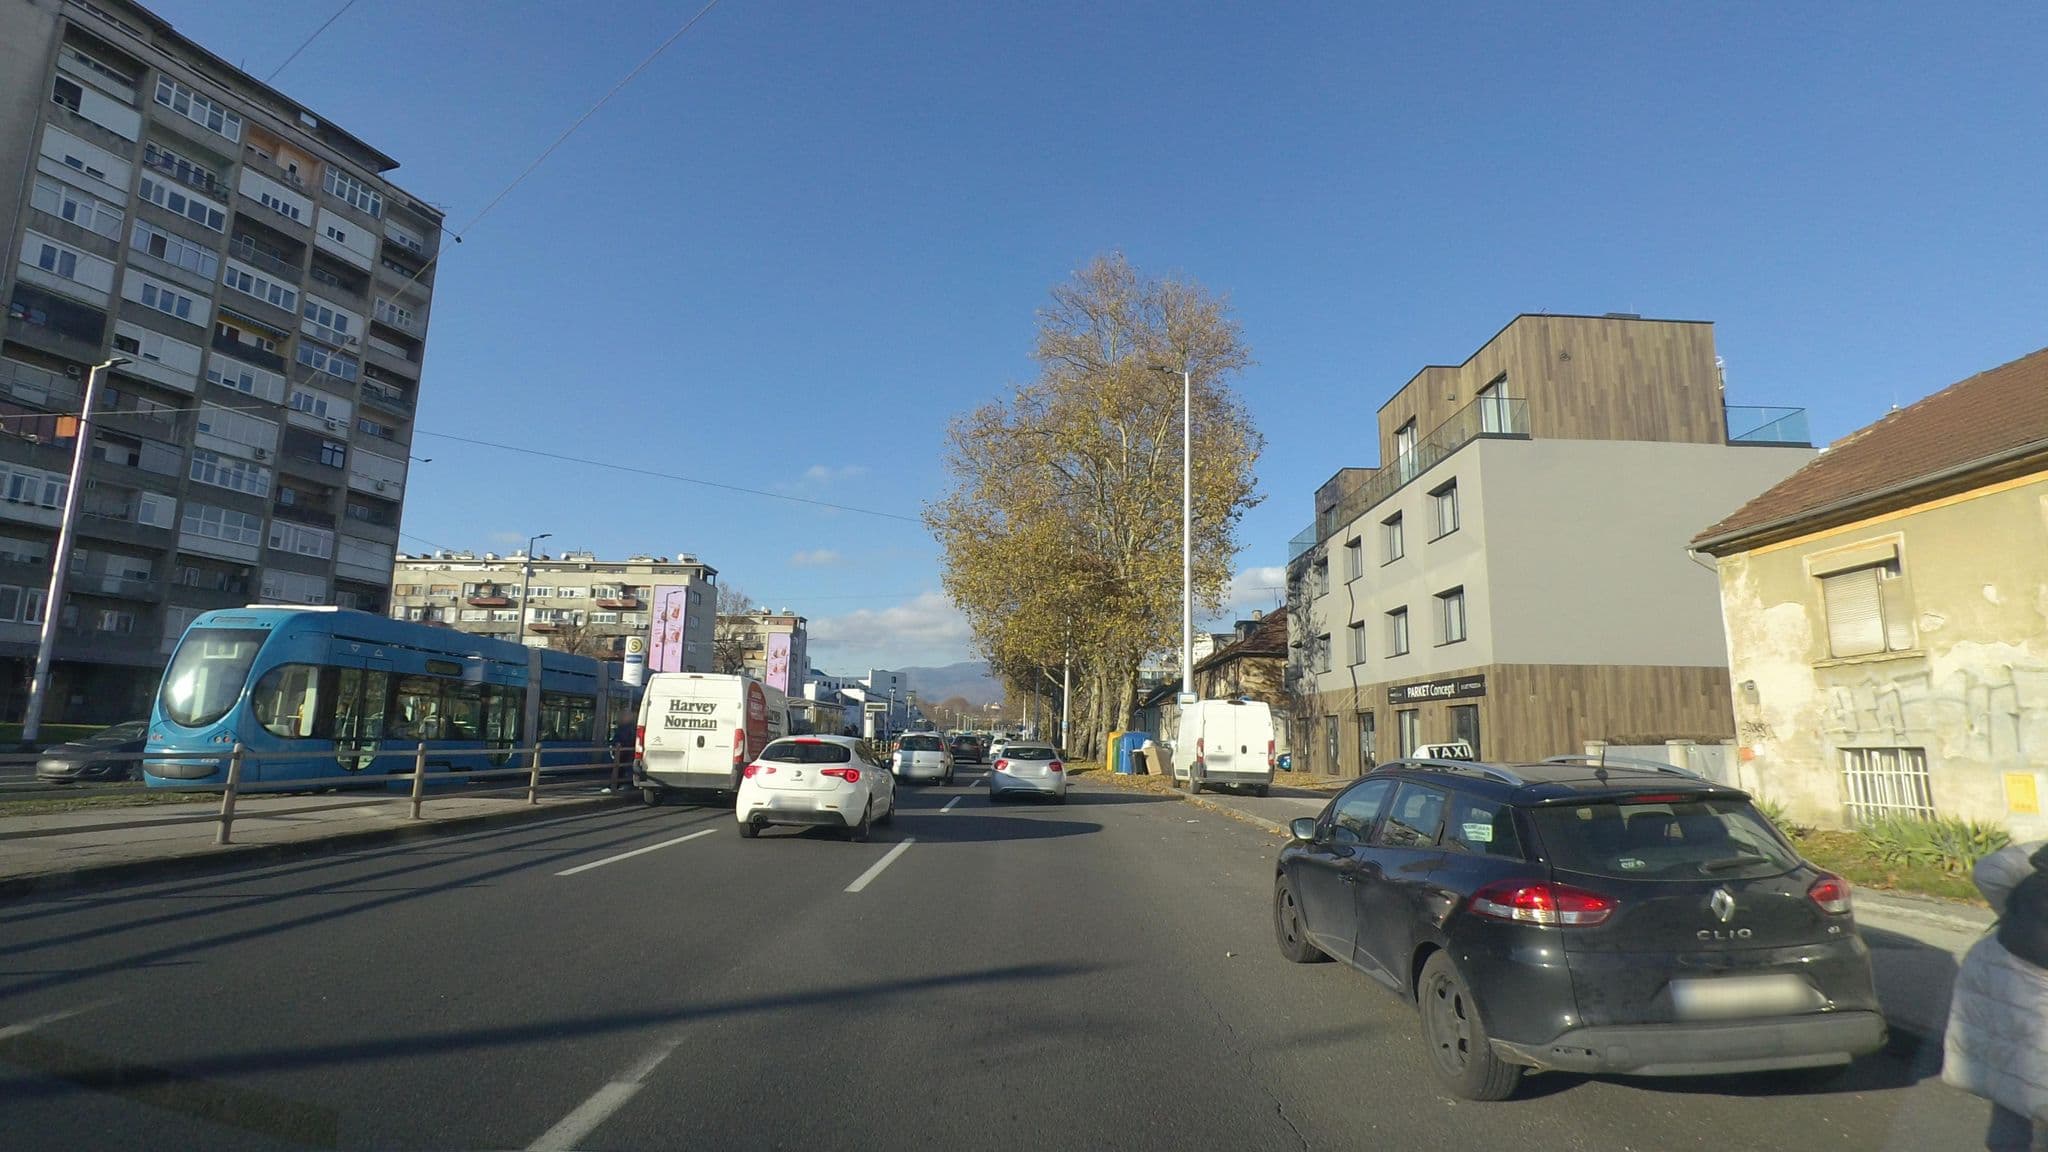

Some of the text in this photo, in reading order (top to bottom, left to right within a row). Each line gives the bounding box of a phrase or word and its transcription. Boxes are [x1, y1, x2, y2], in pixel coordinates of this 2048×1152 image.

[1407, 684, 1430, 698] PARKET
[1430, 683, 1456, 698] Concept
[669, 699, 717, 715] Harvey
[664, 715, 717, 729] Norman
[1430, 746, 1469, 758] TAXI
[1696, 928, 1752, 940] CLIO
